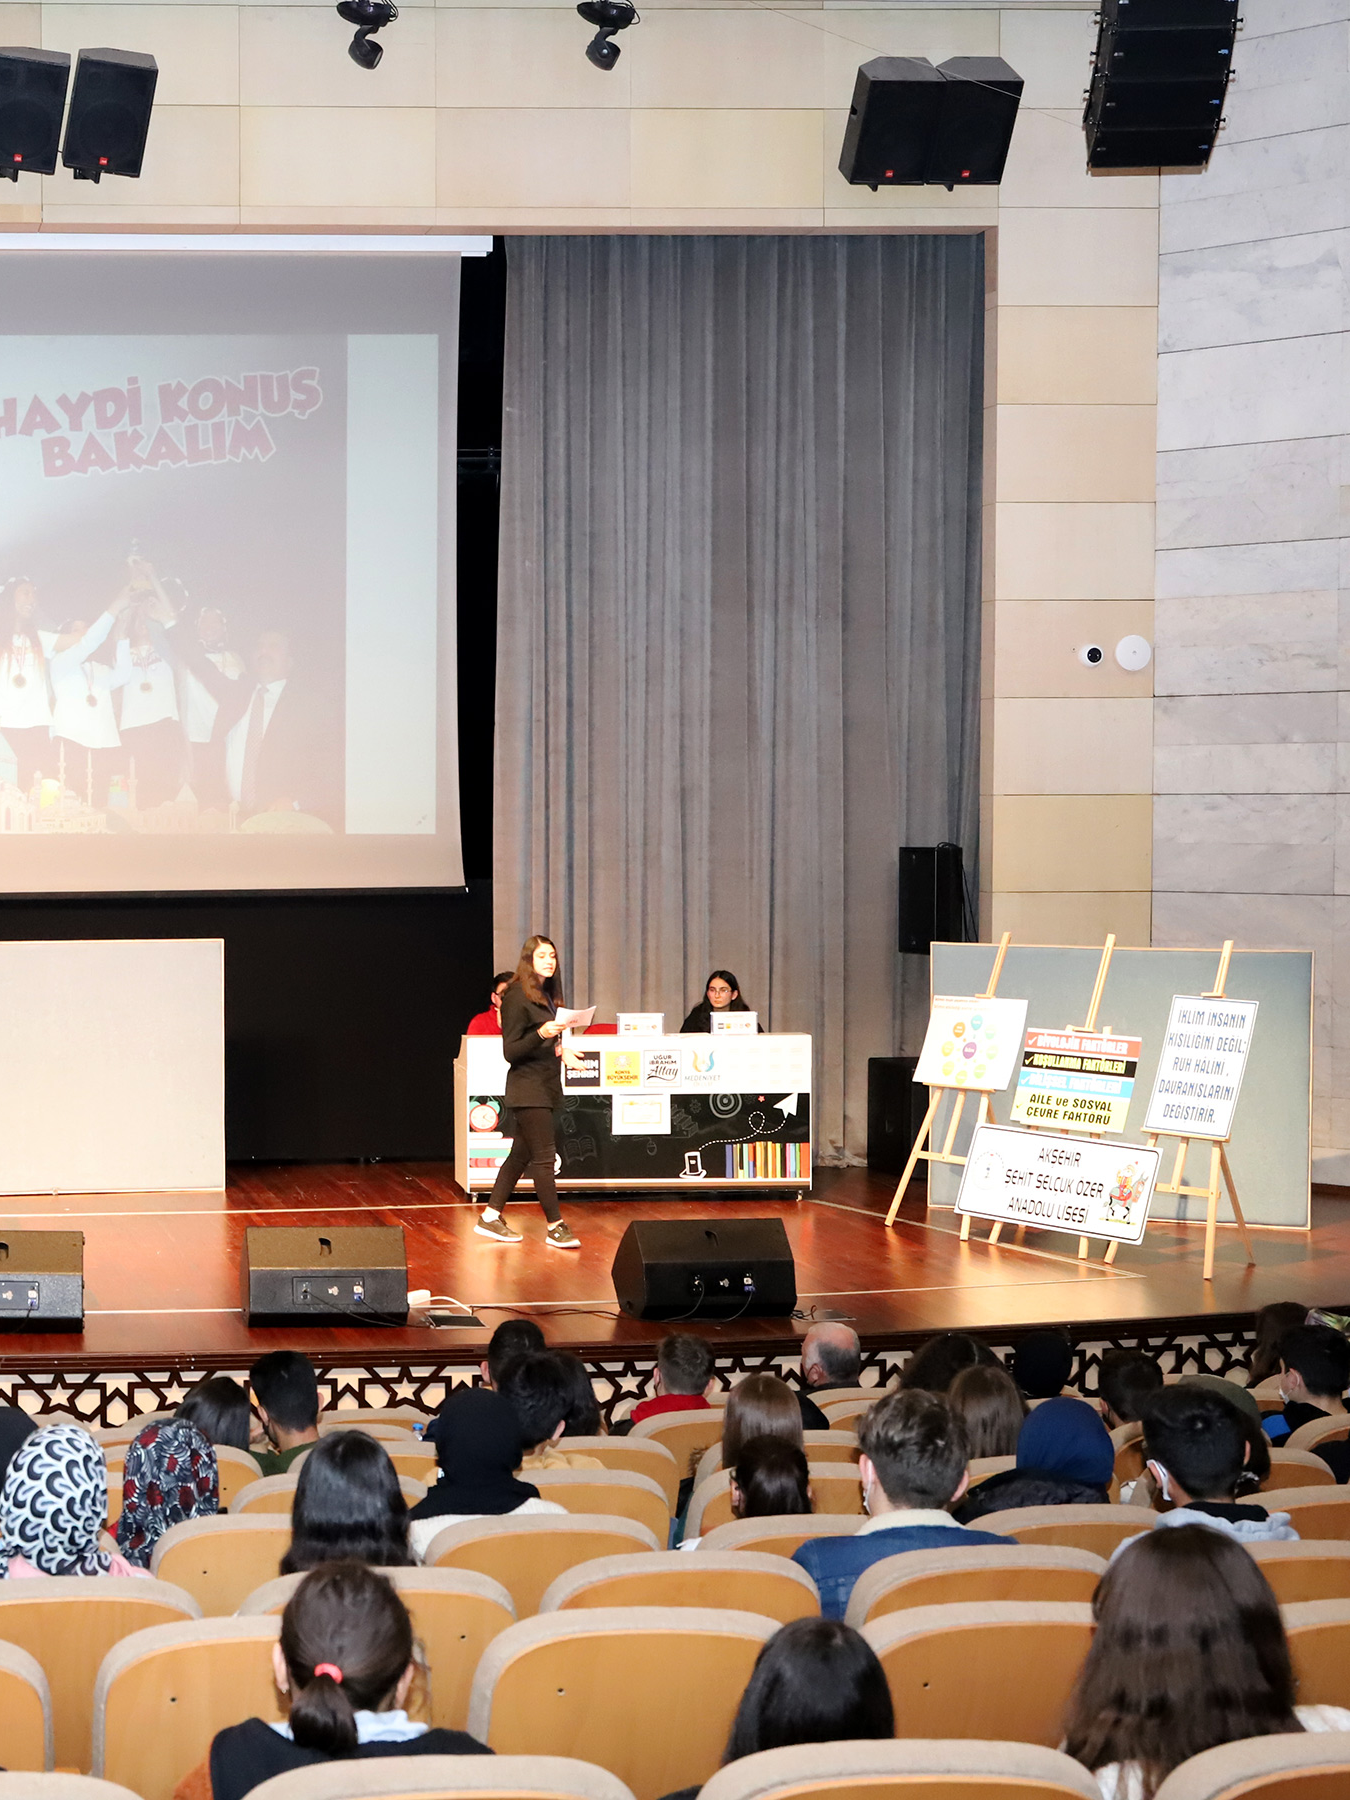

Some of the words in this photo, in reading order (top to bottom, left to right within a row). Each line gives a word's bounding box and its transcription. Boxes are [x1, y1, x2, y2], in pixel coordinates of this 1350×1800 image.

[157, 366, 324, 424] KONUŞ
[40, 417, 277, 478] BAKALIM
[1177, 1006, 1206, 1026] İKLİM
[1207, 1008, 1247, 1029] İNSANIN
[567, 1060, 599, 1069] NİM
[1172, 1056, 1193, 1073] RUH
[1072, 1098, 1112, 1112] SOSYAL
[1037, 1147, 1082, 1168] AKŞEHİR
[1004, 1168, 1034, 1188] ŞEHİT
[1035, 1173, 1074, 1196] SELÇUK
[1075, 1176, 1105, 1199] ÖZER
[1007, 1196, 1055, 1218] ANADOLU
[1056, 1201, 1090, 1224] LİSESİ
